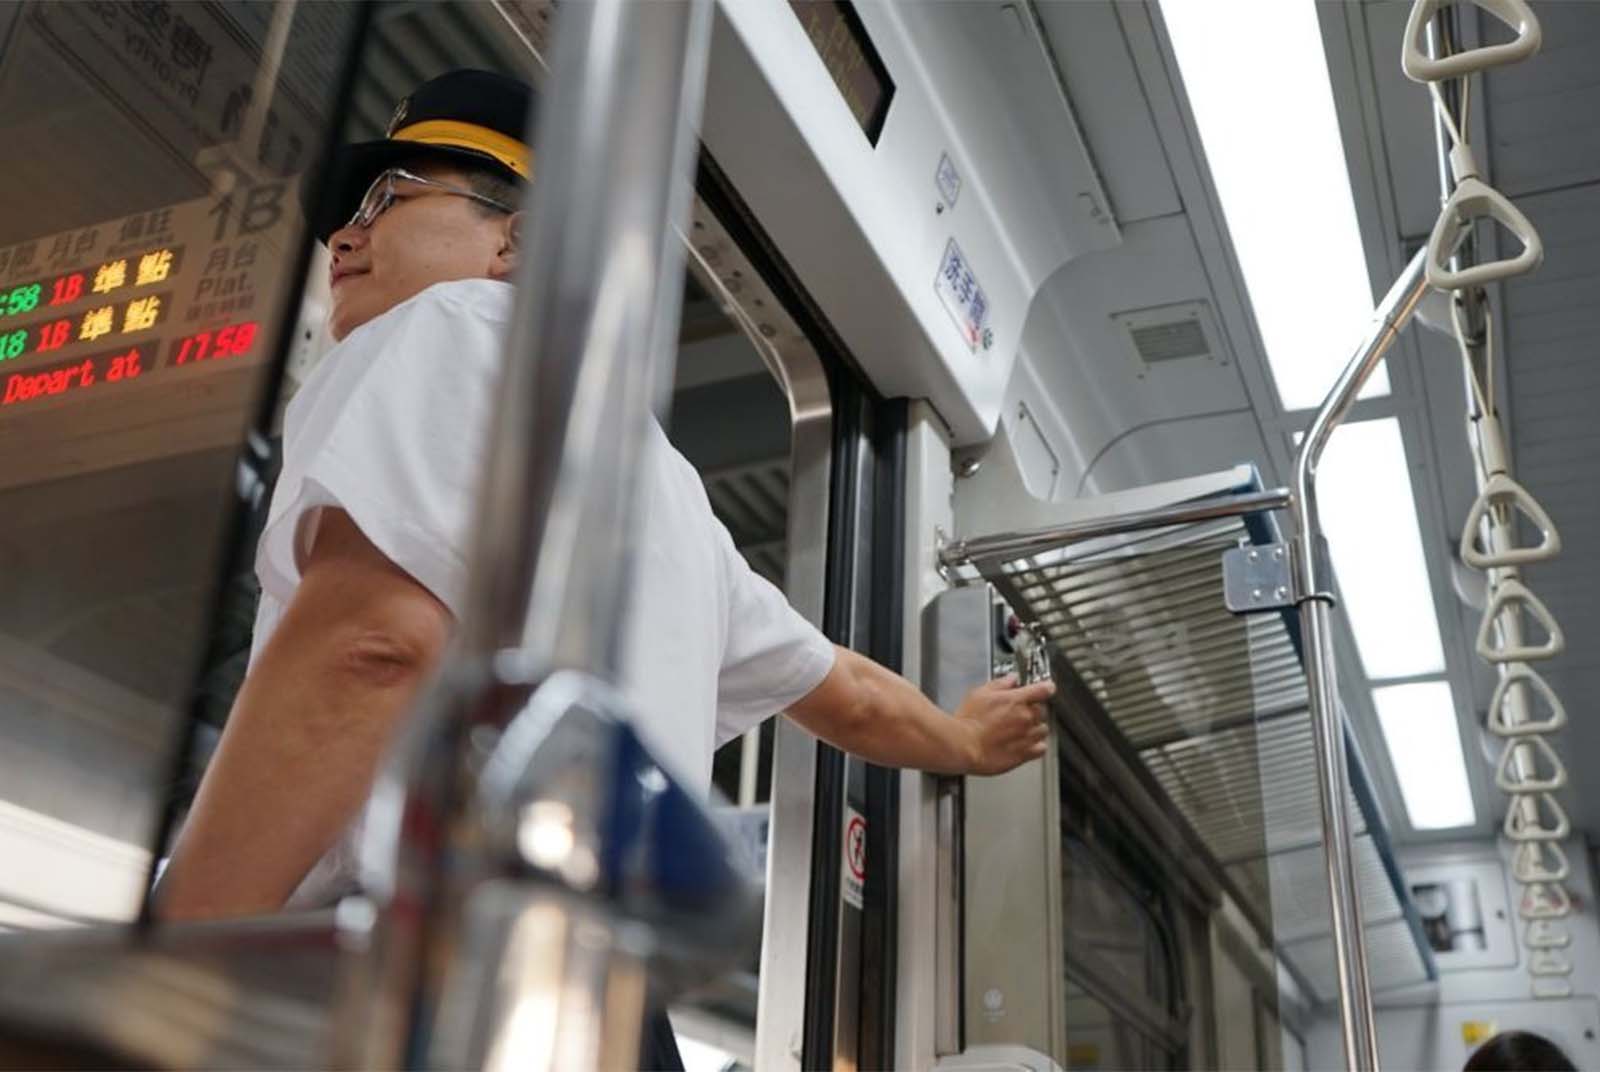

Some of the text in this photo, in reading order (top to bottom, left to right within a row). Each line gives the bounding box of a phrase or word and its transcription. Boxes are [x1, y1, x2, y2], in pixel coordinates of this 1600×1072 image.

[208, 186, 286, 241] 1B
[49, 273, 85, 306] 1B
[92, 249, 174, 293] 準點
[203, 242, 259, 275] 月台
[36, 319, 72, 352] 1B
[79, 295, 161, 340] 準點
[3, 347, 141, 404] Depart at
